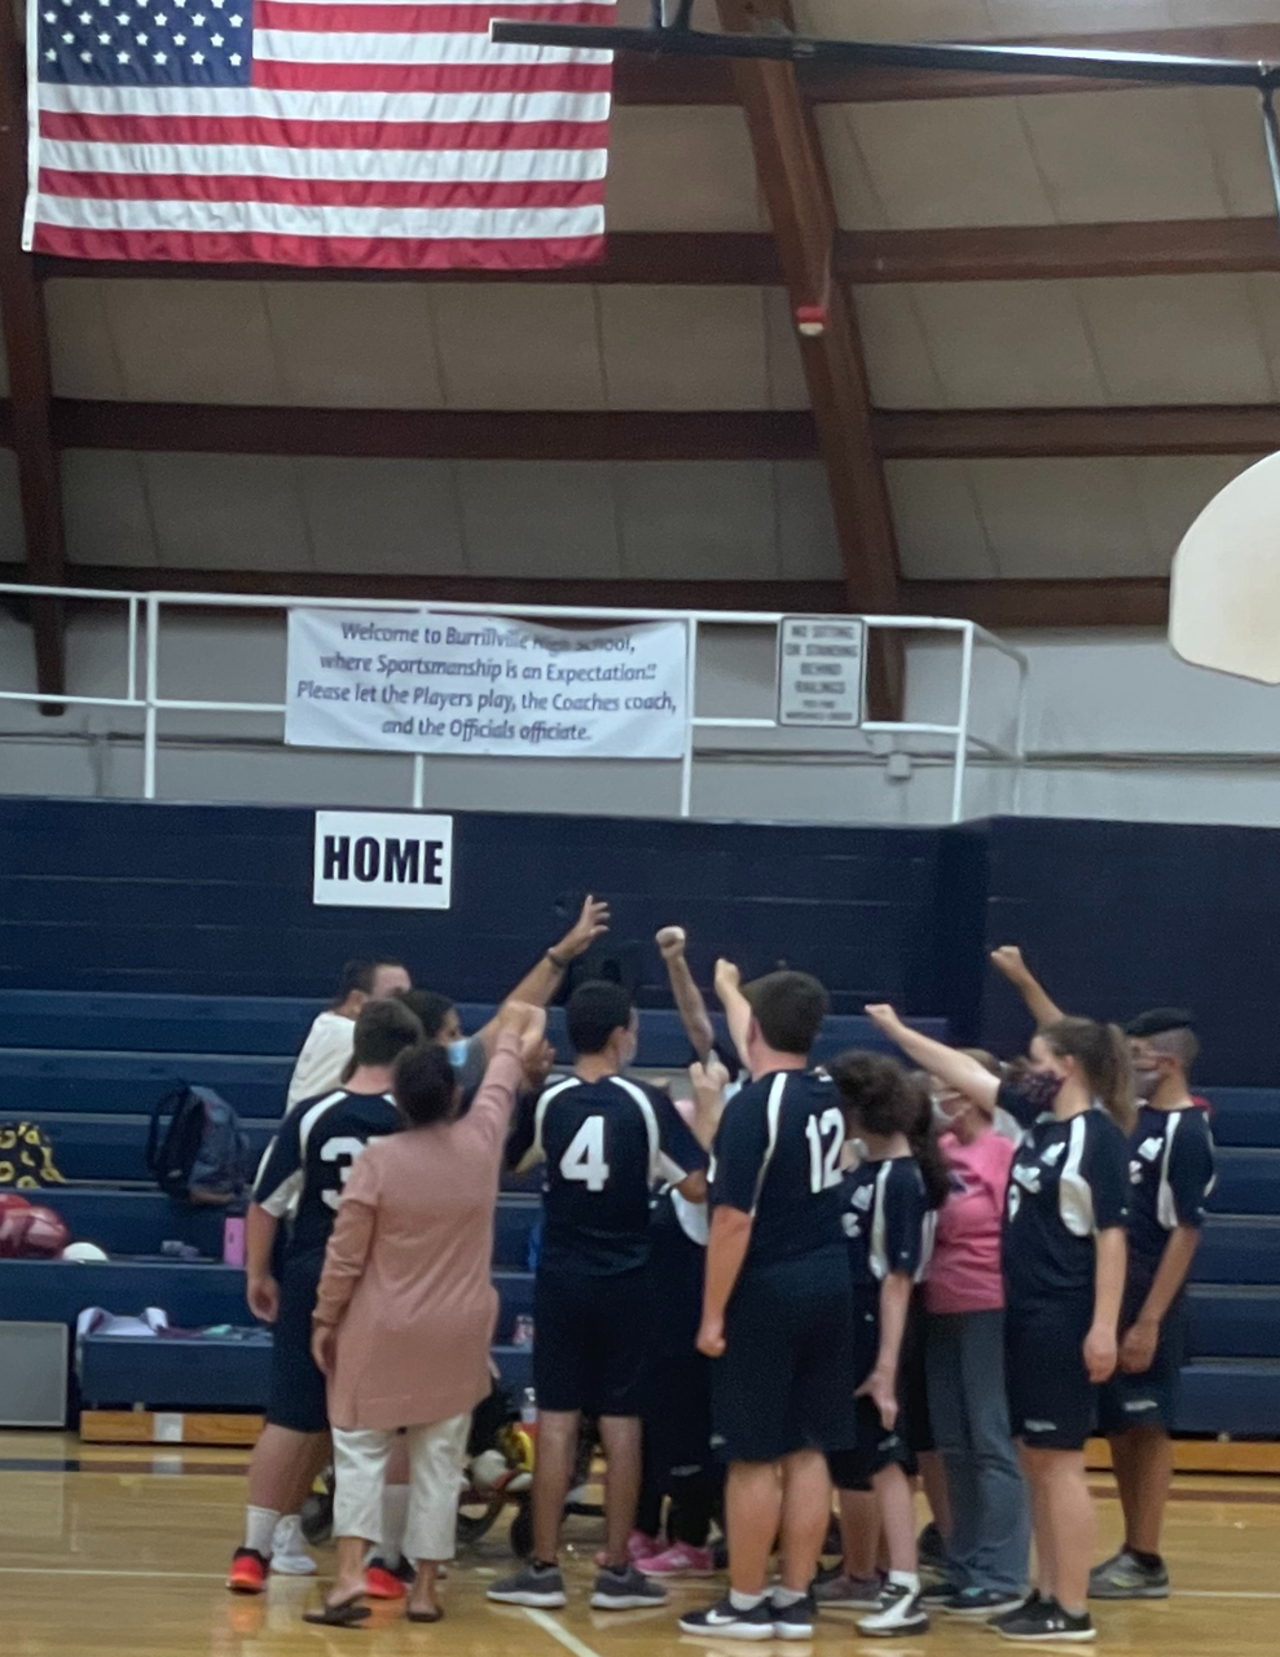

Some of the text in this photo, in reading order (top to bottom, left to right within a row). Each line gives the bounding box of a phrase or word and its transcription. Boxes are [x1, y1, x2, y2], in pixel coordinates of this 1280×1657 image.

[341, 622, 419, 644] Welcome
[424, 627, 441, 645] to
[320, 651, 373, 672] where
[377, 654, 502, 682] Sportsmanship
[506, 659, 518, 679] is
[522, 667, 542, 680] an
[297, 680, 677, 714] Please let the Players play, the Coaches coach,
[381, 716, 592, 743] and the Officials officiate.
[323, 835, 444, 885] HOME
[560, 1115, 609, 1191] 4
[806, 1107, 845, 1193] 12
